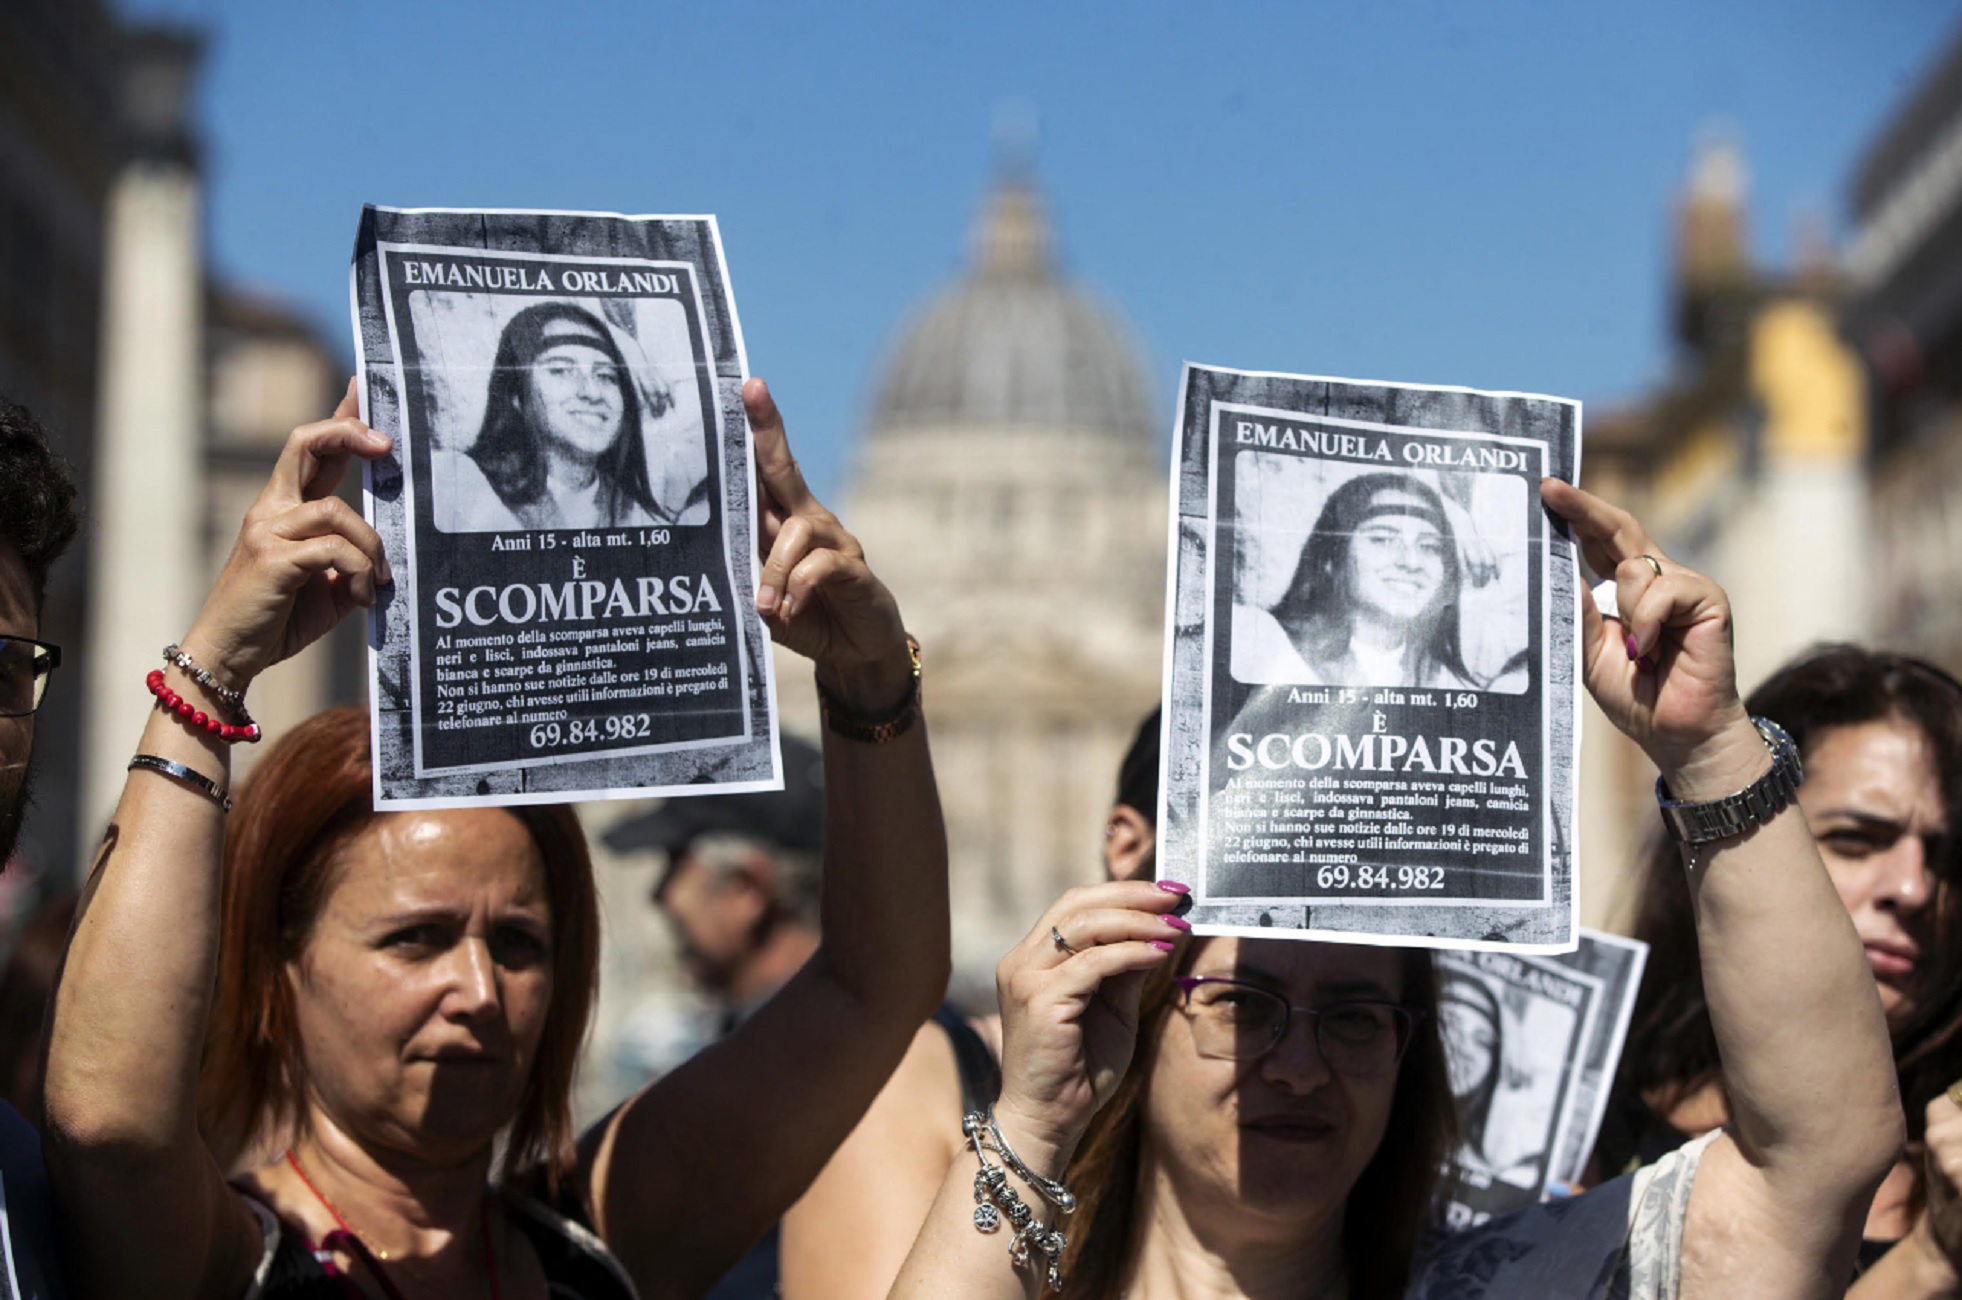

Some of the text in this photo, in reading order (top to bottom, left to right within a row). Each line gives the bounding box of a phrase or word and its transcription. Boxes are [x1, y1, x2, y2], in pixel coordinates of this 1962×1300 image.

[403, 261, 680, 294] EMANUELA ORLANDI
[1235, 421, 1528, 471] EMANUELA ORLANDI
[492, 535, 531, 551] Anni
[539, 534, 556, 549] 15
[573, 532, 600, 548] alta
[607, 532, 632, 546] mt.
[639, 529, 671, 546] 1,60
[572, 555, 586, 579] È
[435, 574, 722, 628] SCOMPARSA
[436, 619, 725, 649] Al momento della scomparsa aveva capelli lunghi,
[436, 634, 725, 666] neri e lisci, indossava pantaloni jeans, camicia
[437, 657, 617, 681] bianca e scarpe da ginnastica.
[438, 663, 728, 698] Non si hanno sue notizie dalle ore 19 di mercoledì
[438, 677, 728, 715] 22 giugno, chi avesse utili informazioni è pregato di
[1287, 688, 1329, 704] Anni
[1337, 689, 1356, 704] 15
[1375, 690, 1405, 706] alta
[1411, 692, 1437, 706] mt.
[1445, 693, 1477, 709] 1,60
[438, 709, 567, 730] telefonare al numero
[530, 713, 650, 748] 69.84.982
[1373, 710, 1387, 733] È
[1226, 733, 1528, 779] SCOMPARSA
[1246, 778, 1305, 789] momento
[1309, 776, 1339, 788] della
[1344, 780, 1407, 793] scomparsa
[1411, 782, 1444, 791] aveva
[1449, 782, 1486, 795] capelli
[1490, 783, 1529, 798] lunghi,
[1259, 794, 1266, 802] e
[1275, 791, 1304, 804] lisci,
[1314, 791, 1373, 805] indossava
[1381, 793, 1438, 808] pantaloni
[1445, 796, 1479, 809] jeans,
[1487, 799, 1529, 811] camicia
[1272, 809, 1279, 817] e
[1284, 808, 1324, 820] scarpe
[1328, 806, 1344, 817] da
[1348, 807, 1414, 820] ginnastica.
[1256, 822, 1266, 832] si
[1270, 821, 1310, 832] hanno
[1314, 824, 1335, 833] sue
[1339, 822, 1380, 834] notizie
[1383, 822, 1410, 835] dalle
[1417, 825, 1437, 835] ore
[1441, 825, 1455, 836] 19
[1458, 824, 1469, 836] di
[1473, 827, 1529, 839] mercoledì
[1224, 836, 1529, 855] 22 giugno, chi avesse utili informazioni è pregato di
[1224, 851, 1358, 864] telefonare al numero
[1317, 865, 1445, 889] 69.84.982
